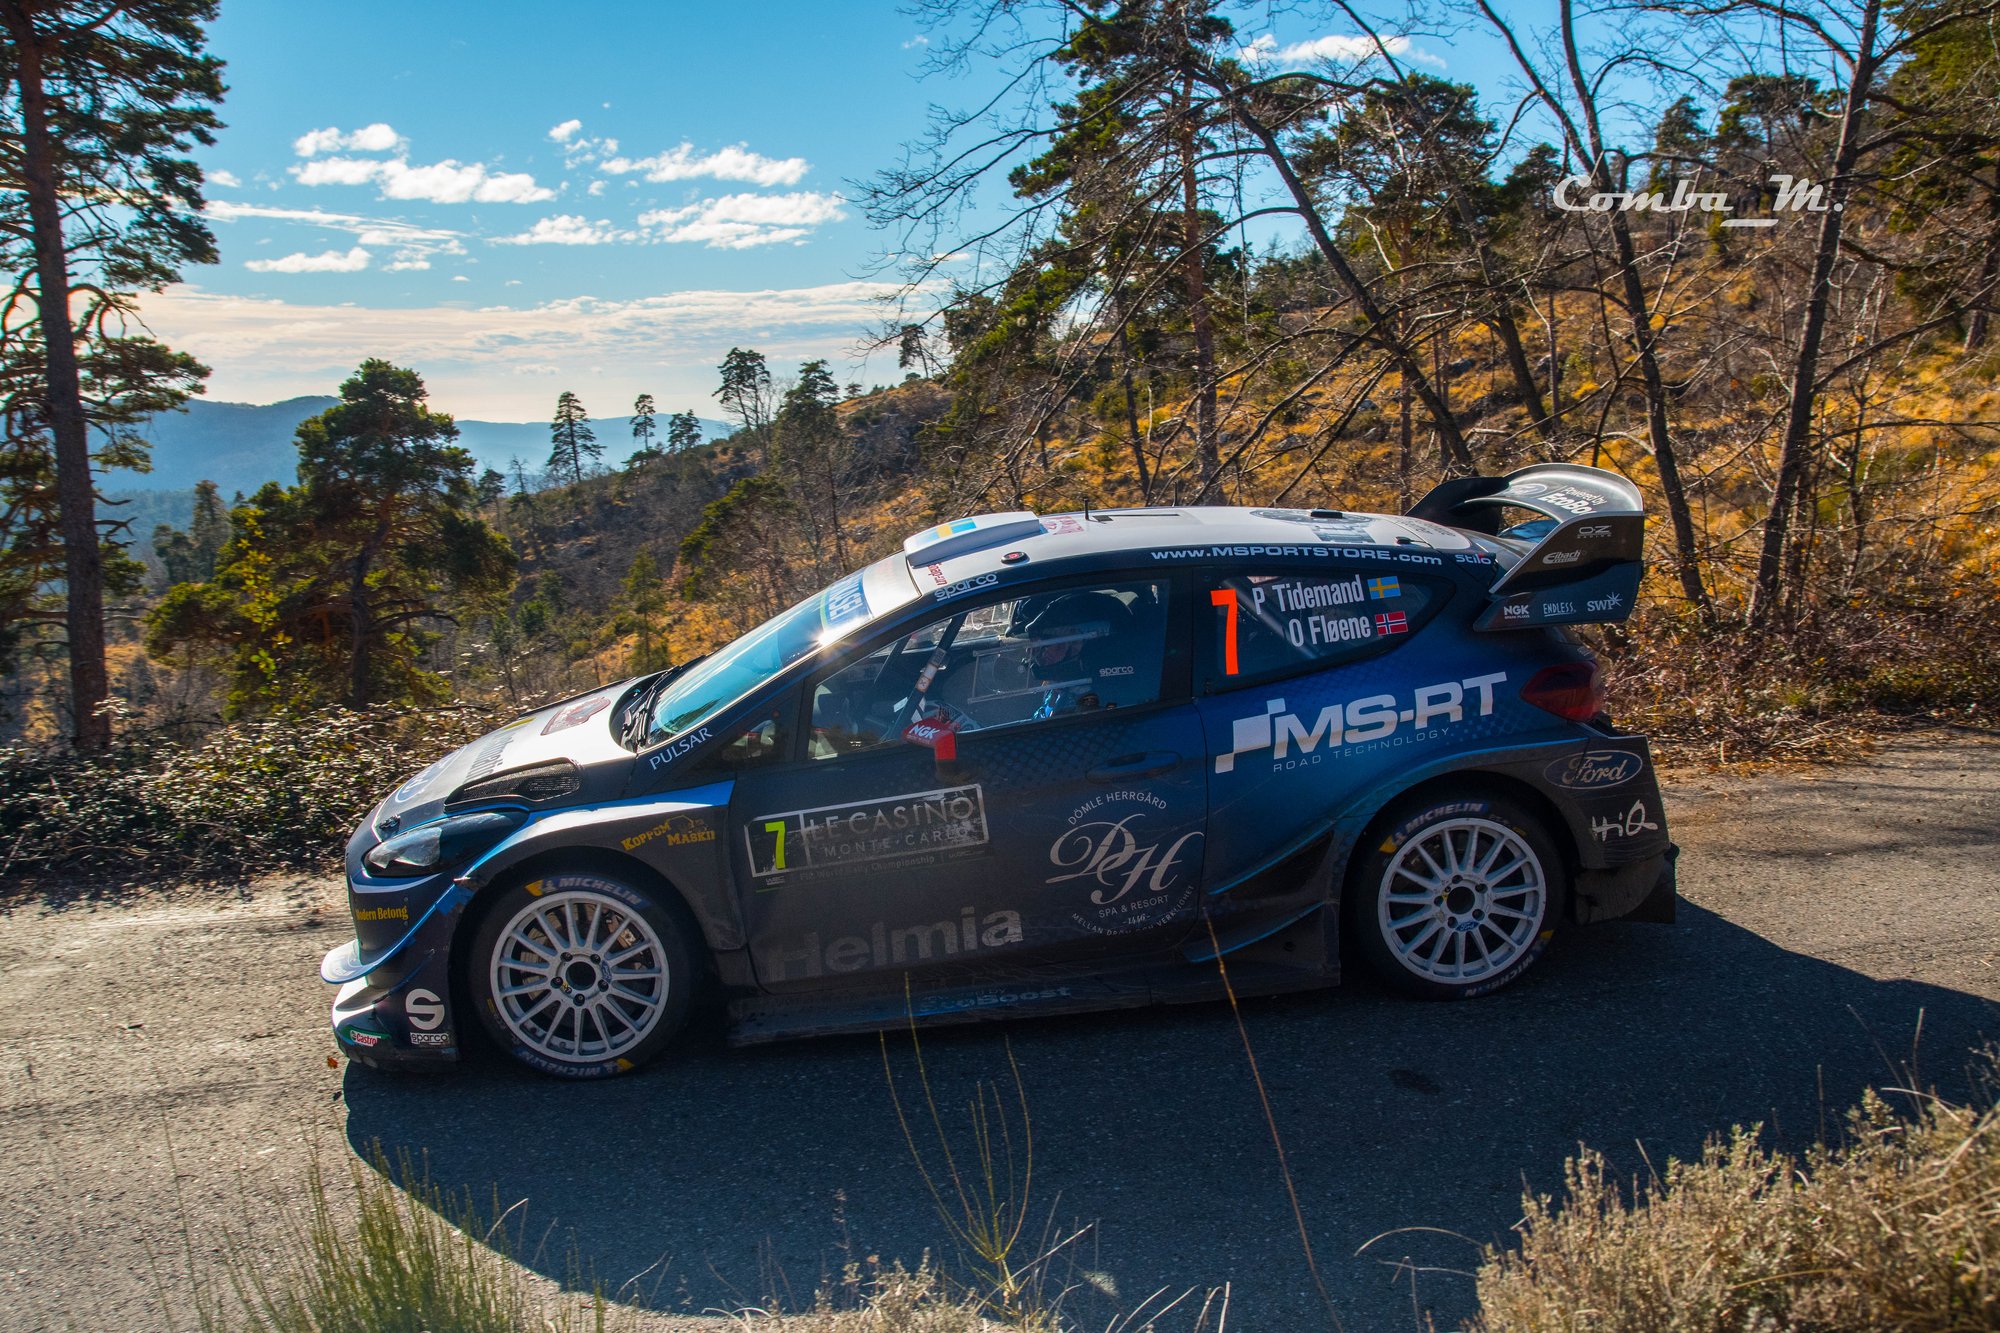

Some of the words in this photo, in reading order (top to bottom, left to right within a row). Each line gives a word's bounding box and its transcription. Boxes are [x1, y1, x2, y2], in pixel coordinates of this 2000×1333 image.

[1151, 546, 1442, 566] www.MSPORTSTORE.com
[1455, 553, 1492, 565] Stilo
[934, 573, 998, 601] sparco
[1252, 587, 1265, 615] P
[1272, 574, 1365, 612] Tidemand
[1503, 604, 1530, 617] NGK
[1587, 599, 1616, 612] SWP
[1210, 588, 1240, 676] 7
[1308, 614, 1371, 645] Fløene
[1100, 665, 1134, 677] sparco
[1273, 671, 1508, 760] MS-RT
[908, 724, 940, 741] NGK
[649, 727, 714, 771] PULSAR
[1273, 755, 1321, 773] ROAD
[1333, 728, 1450, 759] TECHNOLOGY
[1562, 755, 1628, 785] Ford
[849, 796, 974, 836] CASINO
[1068, 796, 1104, 825] DÖMLE
[1106, 791, 1167, 811] HERRGÅRD
[1404, 802, 1483, 830] MICHELIN
[621, 821, 671, 851] KOPPOM
[765, 821, 786, 870] 7
[559, 876, 643, 906] MICHELIN
[377, 905, 408, 921] Betong
[1099, 906, 1118, 919] SPA
[1121, 904, 1129, 913] &
[1130, 894, 1169, 910] RESORT
[1071, 912, 1104, 934] MELLAN
[768, 905, 1024, 982] Helmia
[411, 1032, 448, 1045] sparco
